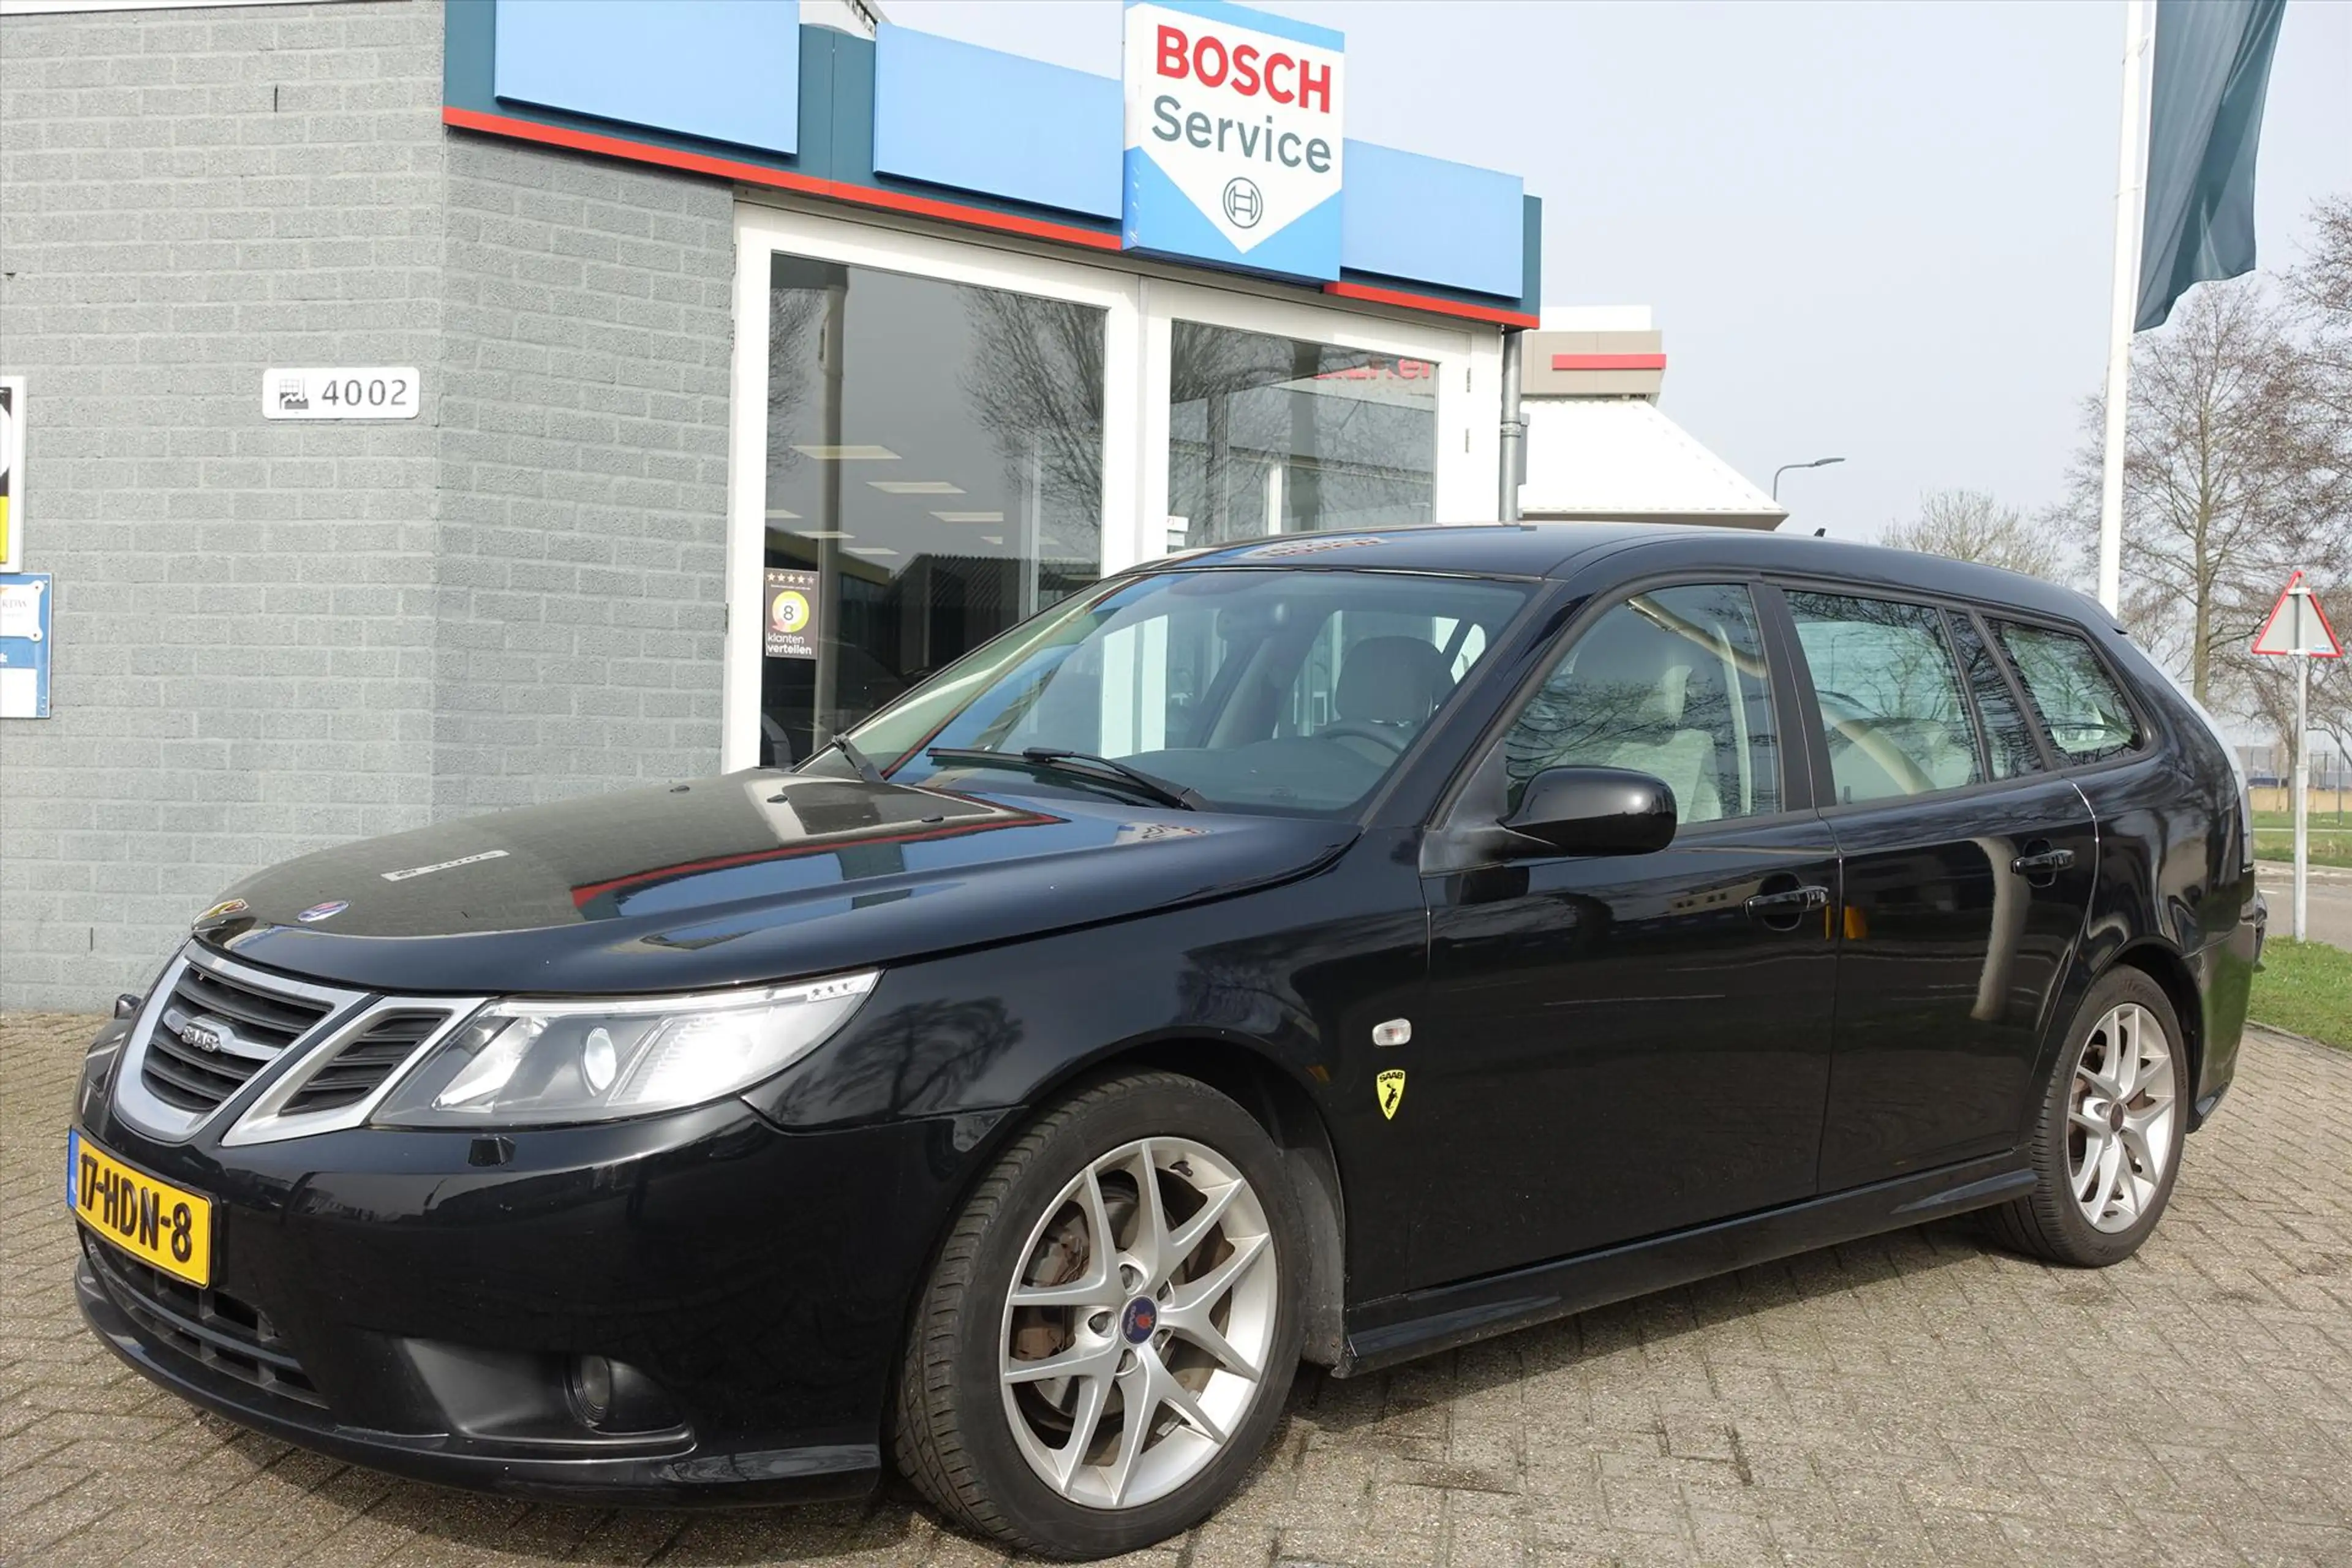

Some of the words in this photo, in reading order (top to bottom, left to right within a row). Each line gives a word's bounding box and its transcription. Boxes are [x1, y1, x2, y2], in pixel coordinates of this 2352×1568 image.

[1156, 23, 1331, 114] BOSCH
[1152, 94, 1332, 173] Service
[322, 380, 407, 406] 4002
[784, 605, 794, 620] 8
[767, 633, 804, 644] klanten
[767, 644, 812, 655] vertellen
[181, 1025, 219, 1052] SAAB
[1379, 1072, 1403, 1082] SAAB
[81, 1152, 192, 1264] 17-HDN-8
